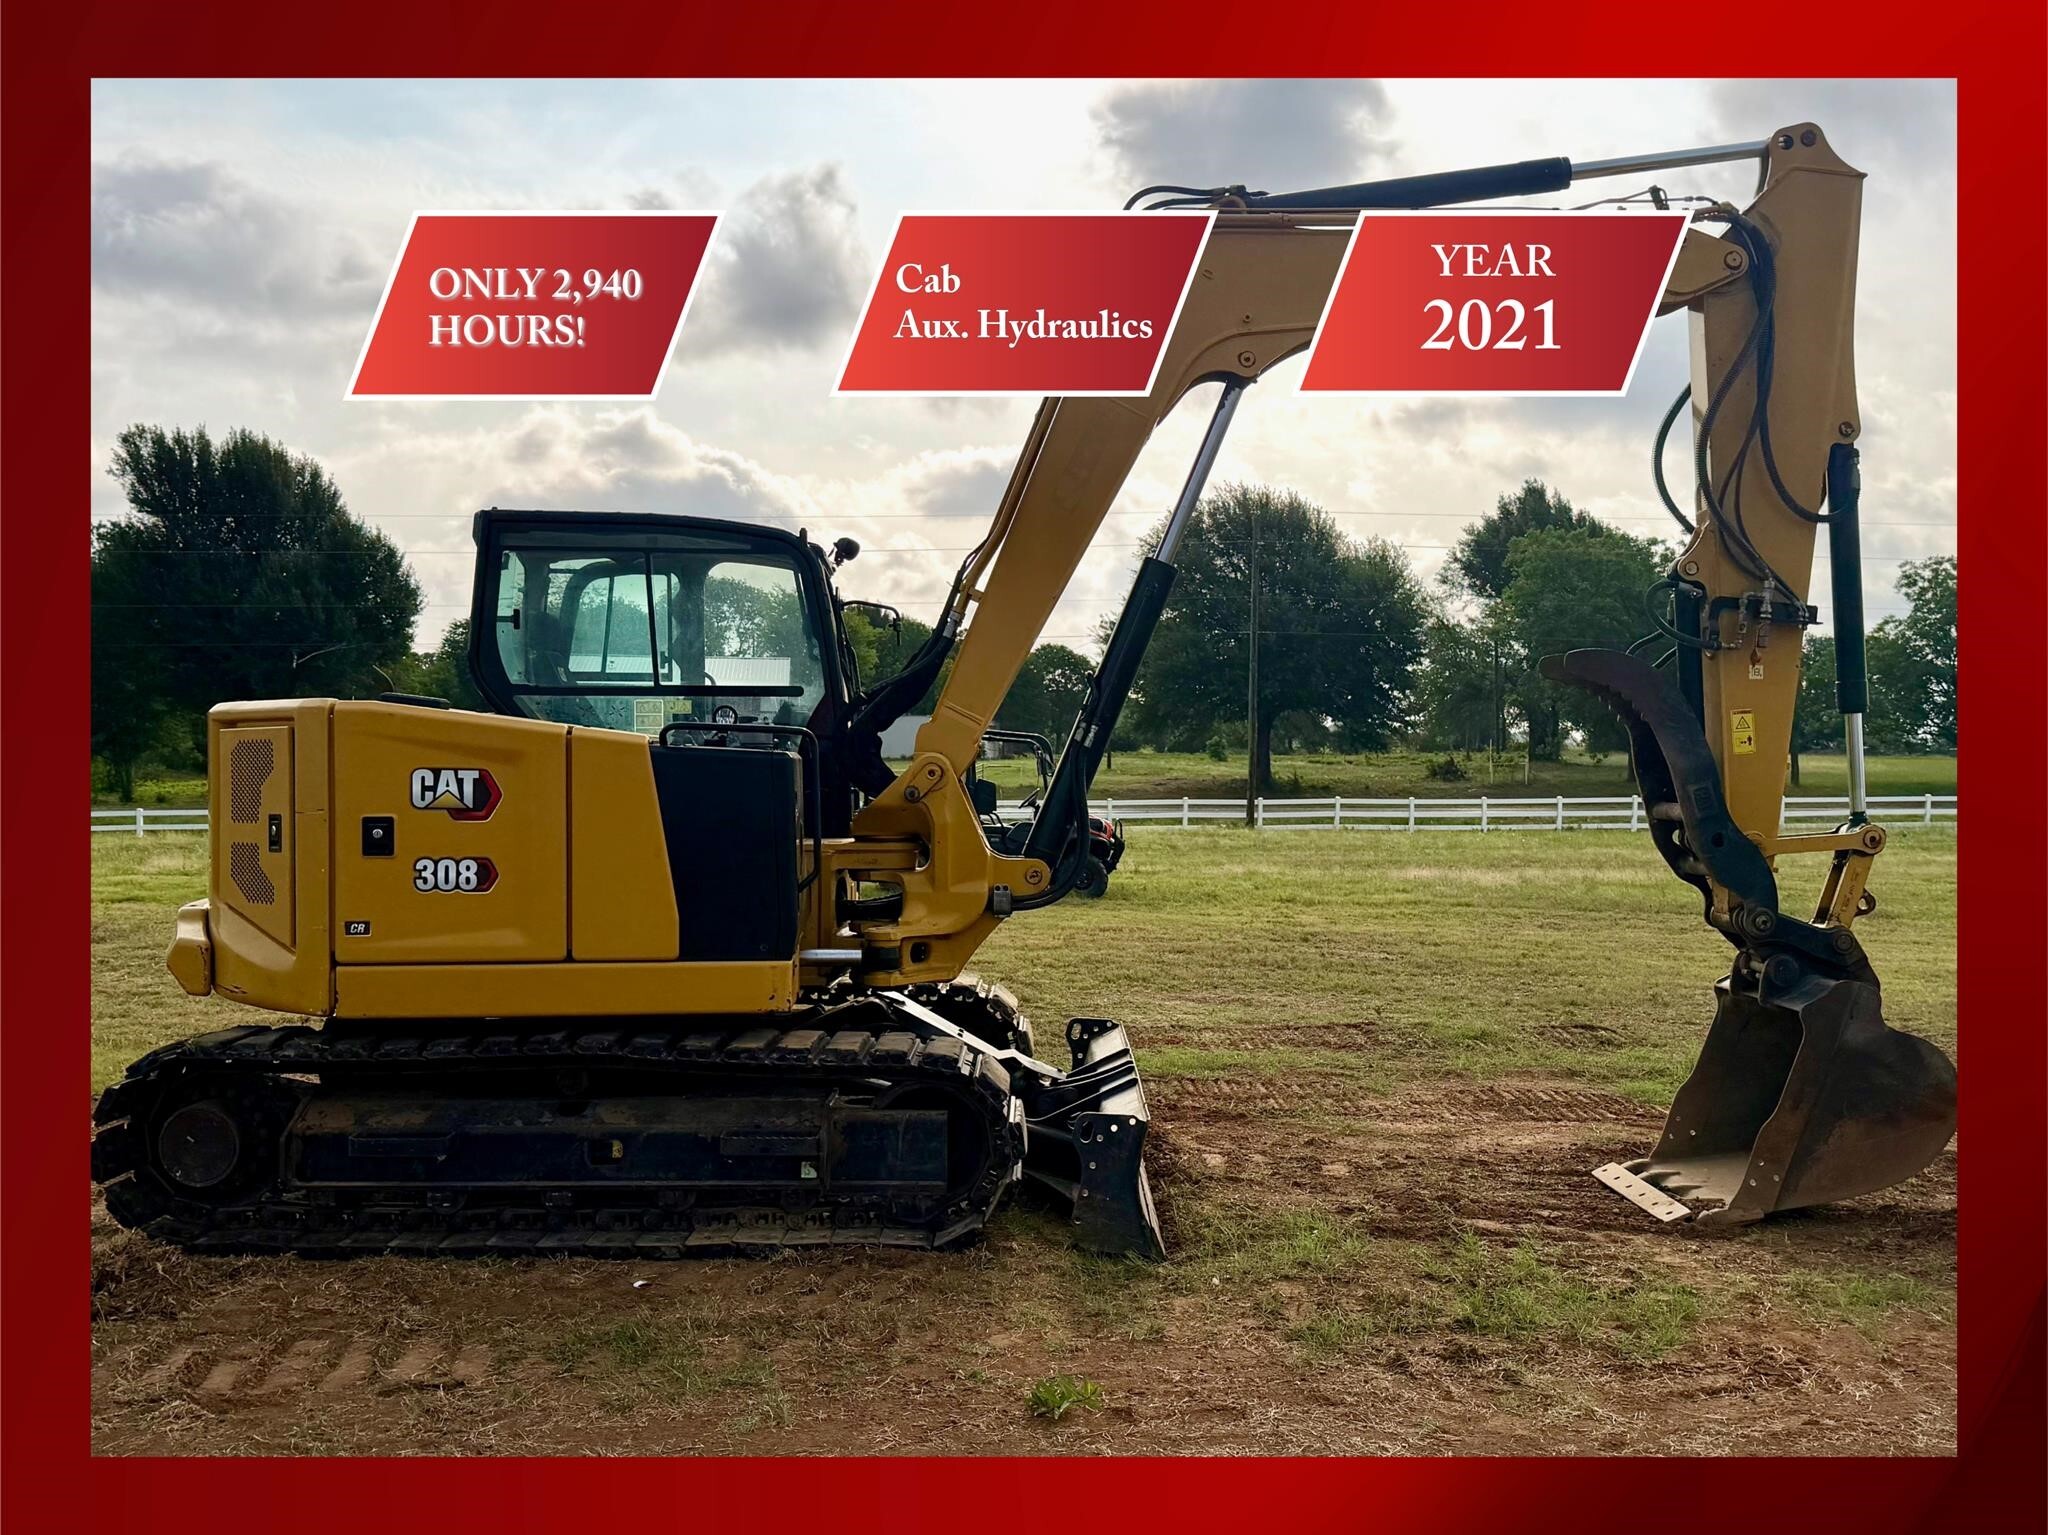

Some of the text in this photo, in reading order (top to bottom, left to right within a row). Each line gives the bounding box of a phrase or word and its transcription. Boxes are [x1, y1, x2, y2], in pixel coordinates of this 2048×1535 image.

[412, 768, 480, 809] CAT
[415, 859, 478, 891] 308
[350, 923, 366, 934] CR
